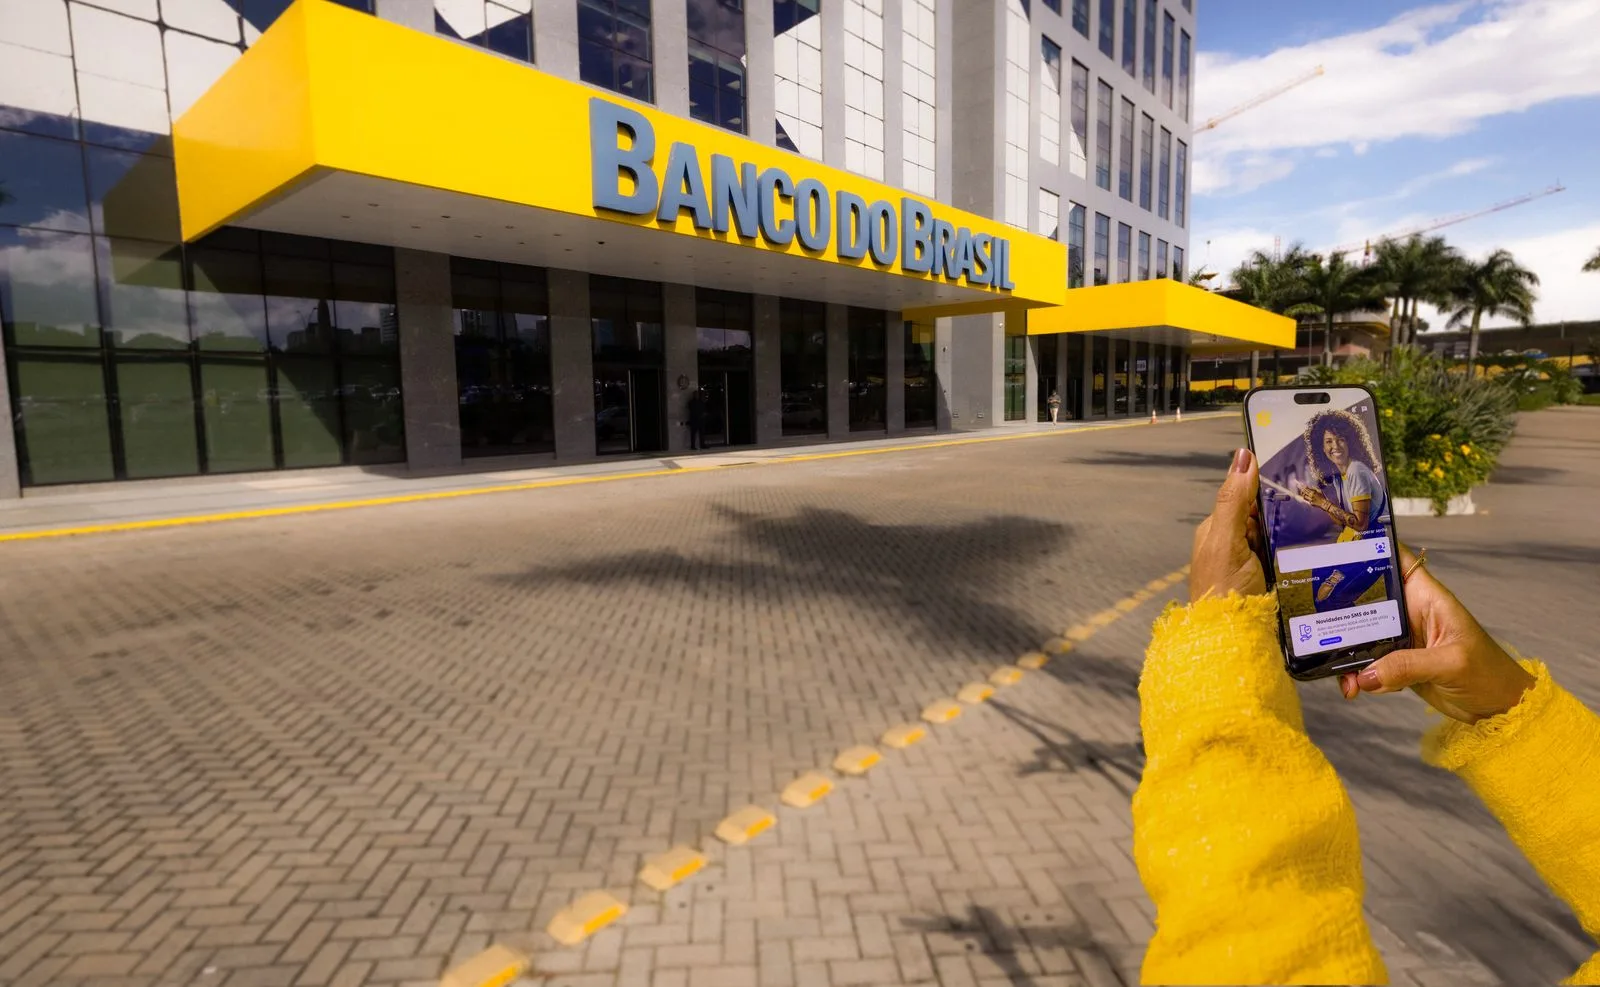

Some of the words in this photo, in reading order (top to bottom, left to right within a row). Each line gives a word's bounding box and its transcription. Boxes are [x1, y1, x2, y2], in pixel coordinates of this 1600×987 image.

[590, 97, 831, 251] BANCO
[836, 190, 898, 266] DO
[901, 197, 1015, 290] BRASIL
[1316, 616, 1343, 625] Novidades
